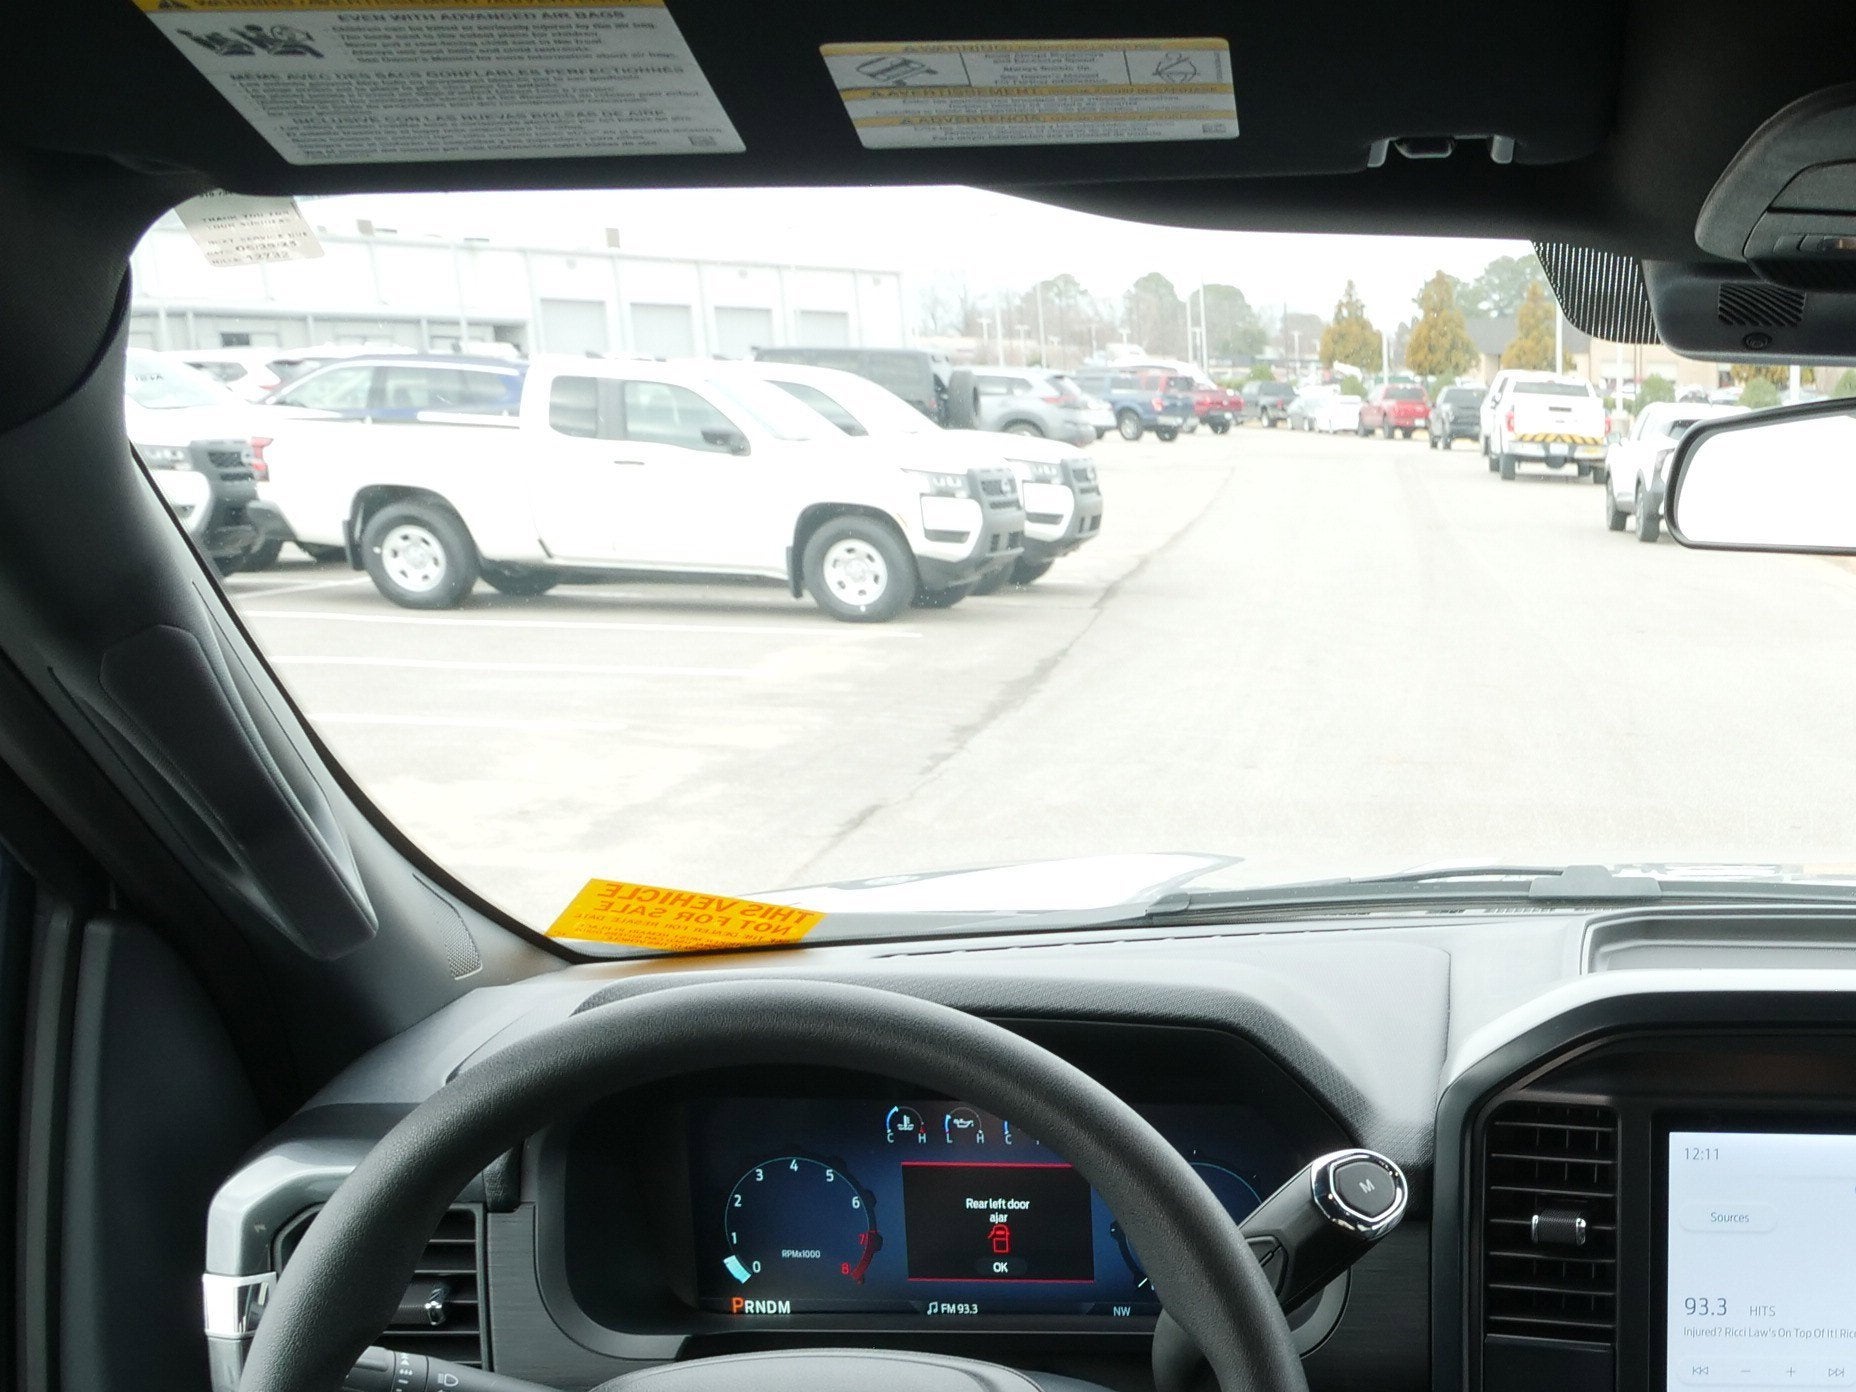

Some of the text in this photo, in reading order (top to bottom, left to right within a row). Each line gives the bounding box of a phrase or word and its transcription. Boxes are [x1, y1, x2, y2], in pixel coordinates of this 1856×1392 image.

[887, 1133, 894, 1143] C
[918, 1133, 927, 1143] H
[946, 1133, 953, 1143] L
[976, 1133, 985, 1144] H
[1004, 1134, 1012, 1145] C
[1684, 1148, 1720, 1162] 12:11
[790, 1159, 798, 1172] 4
[755, 1169, 764, 1182] 3
[826, 1169, 834, 1182] 5
[734, 1195, 742, 1207] 2
[852, 1196, 860, 1209] 6
[966, 1198, 1030, 1210] Rear left door
[989, 1212, 1008, 1224] ajar
[1710, 1211, 1750, 1224] Sources
[731, 1232, 737, 1244] 1
[858, 1233, 866, 1245] 7
[782, 1250, 821, 1259] RPMx1000
[752, 1261, 761, 1273] 0
[841, 1262, 850, 1275] 8
[993, 1262, 1008, 1273] OK
[731, 1296, 791, 1314] PRNDM
[941, 1303, 978, 1315] FM 93.3
[1684, 1297, 1776, 1317] 93.3 HITS
[1113, 1306, 1131, 1317] NW
[1683, 1327, 1722, 1338] Injured?
[1778, 1328, 1792, 1338] On
[1794, 1328, 1812, 1340] Top
[1813, 1328, 1825, 1338] Of
